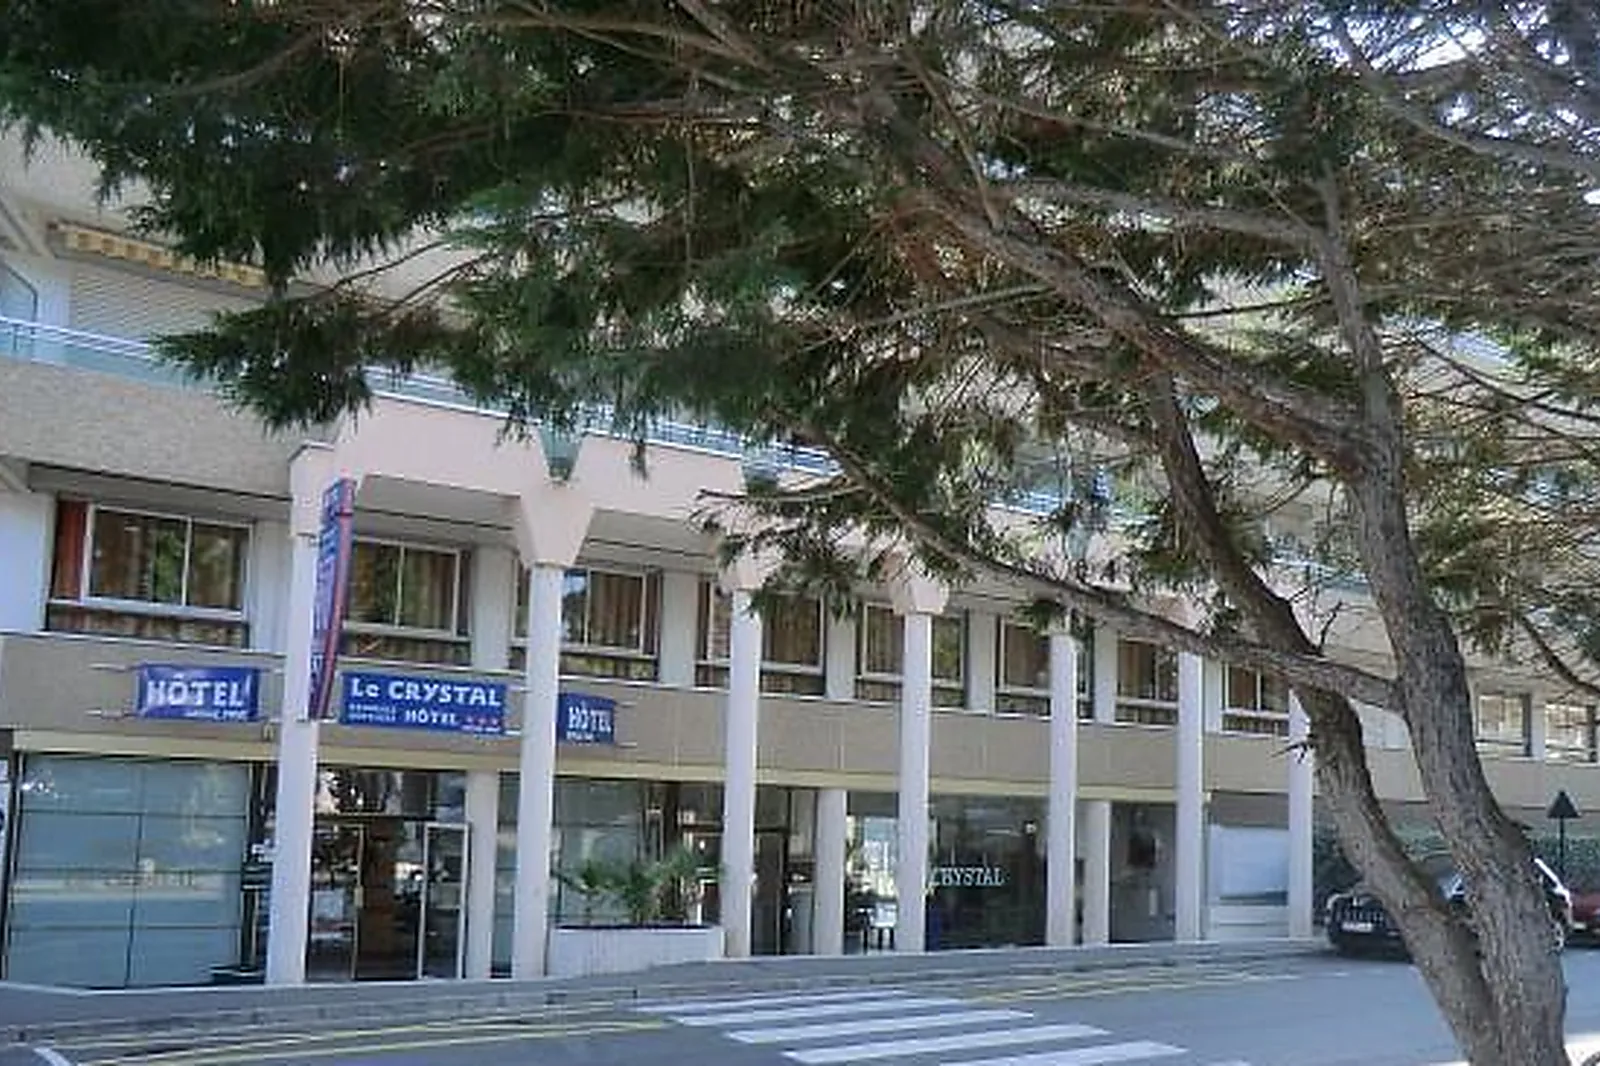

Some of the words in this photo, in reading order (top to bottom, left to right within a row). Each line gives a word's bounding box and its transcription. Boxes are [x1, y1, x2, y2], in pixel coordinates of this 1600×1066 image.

[147, 673, 244, 706] HÔTEL
[351, 677, 380, 698] Le
[388, 680, 502, 706] CRYSTAL
[405, 708, 459, 725] HÔTEL
